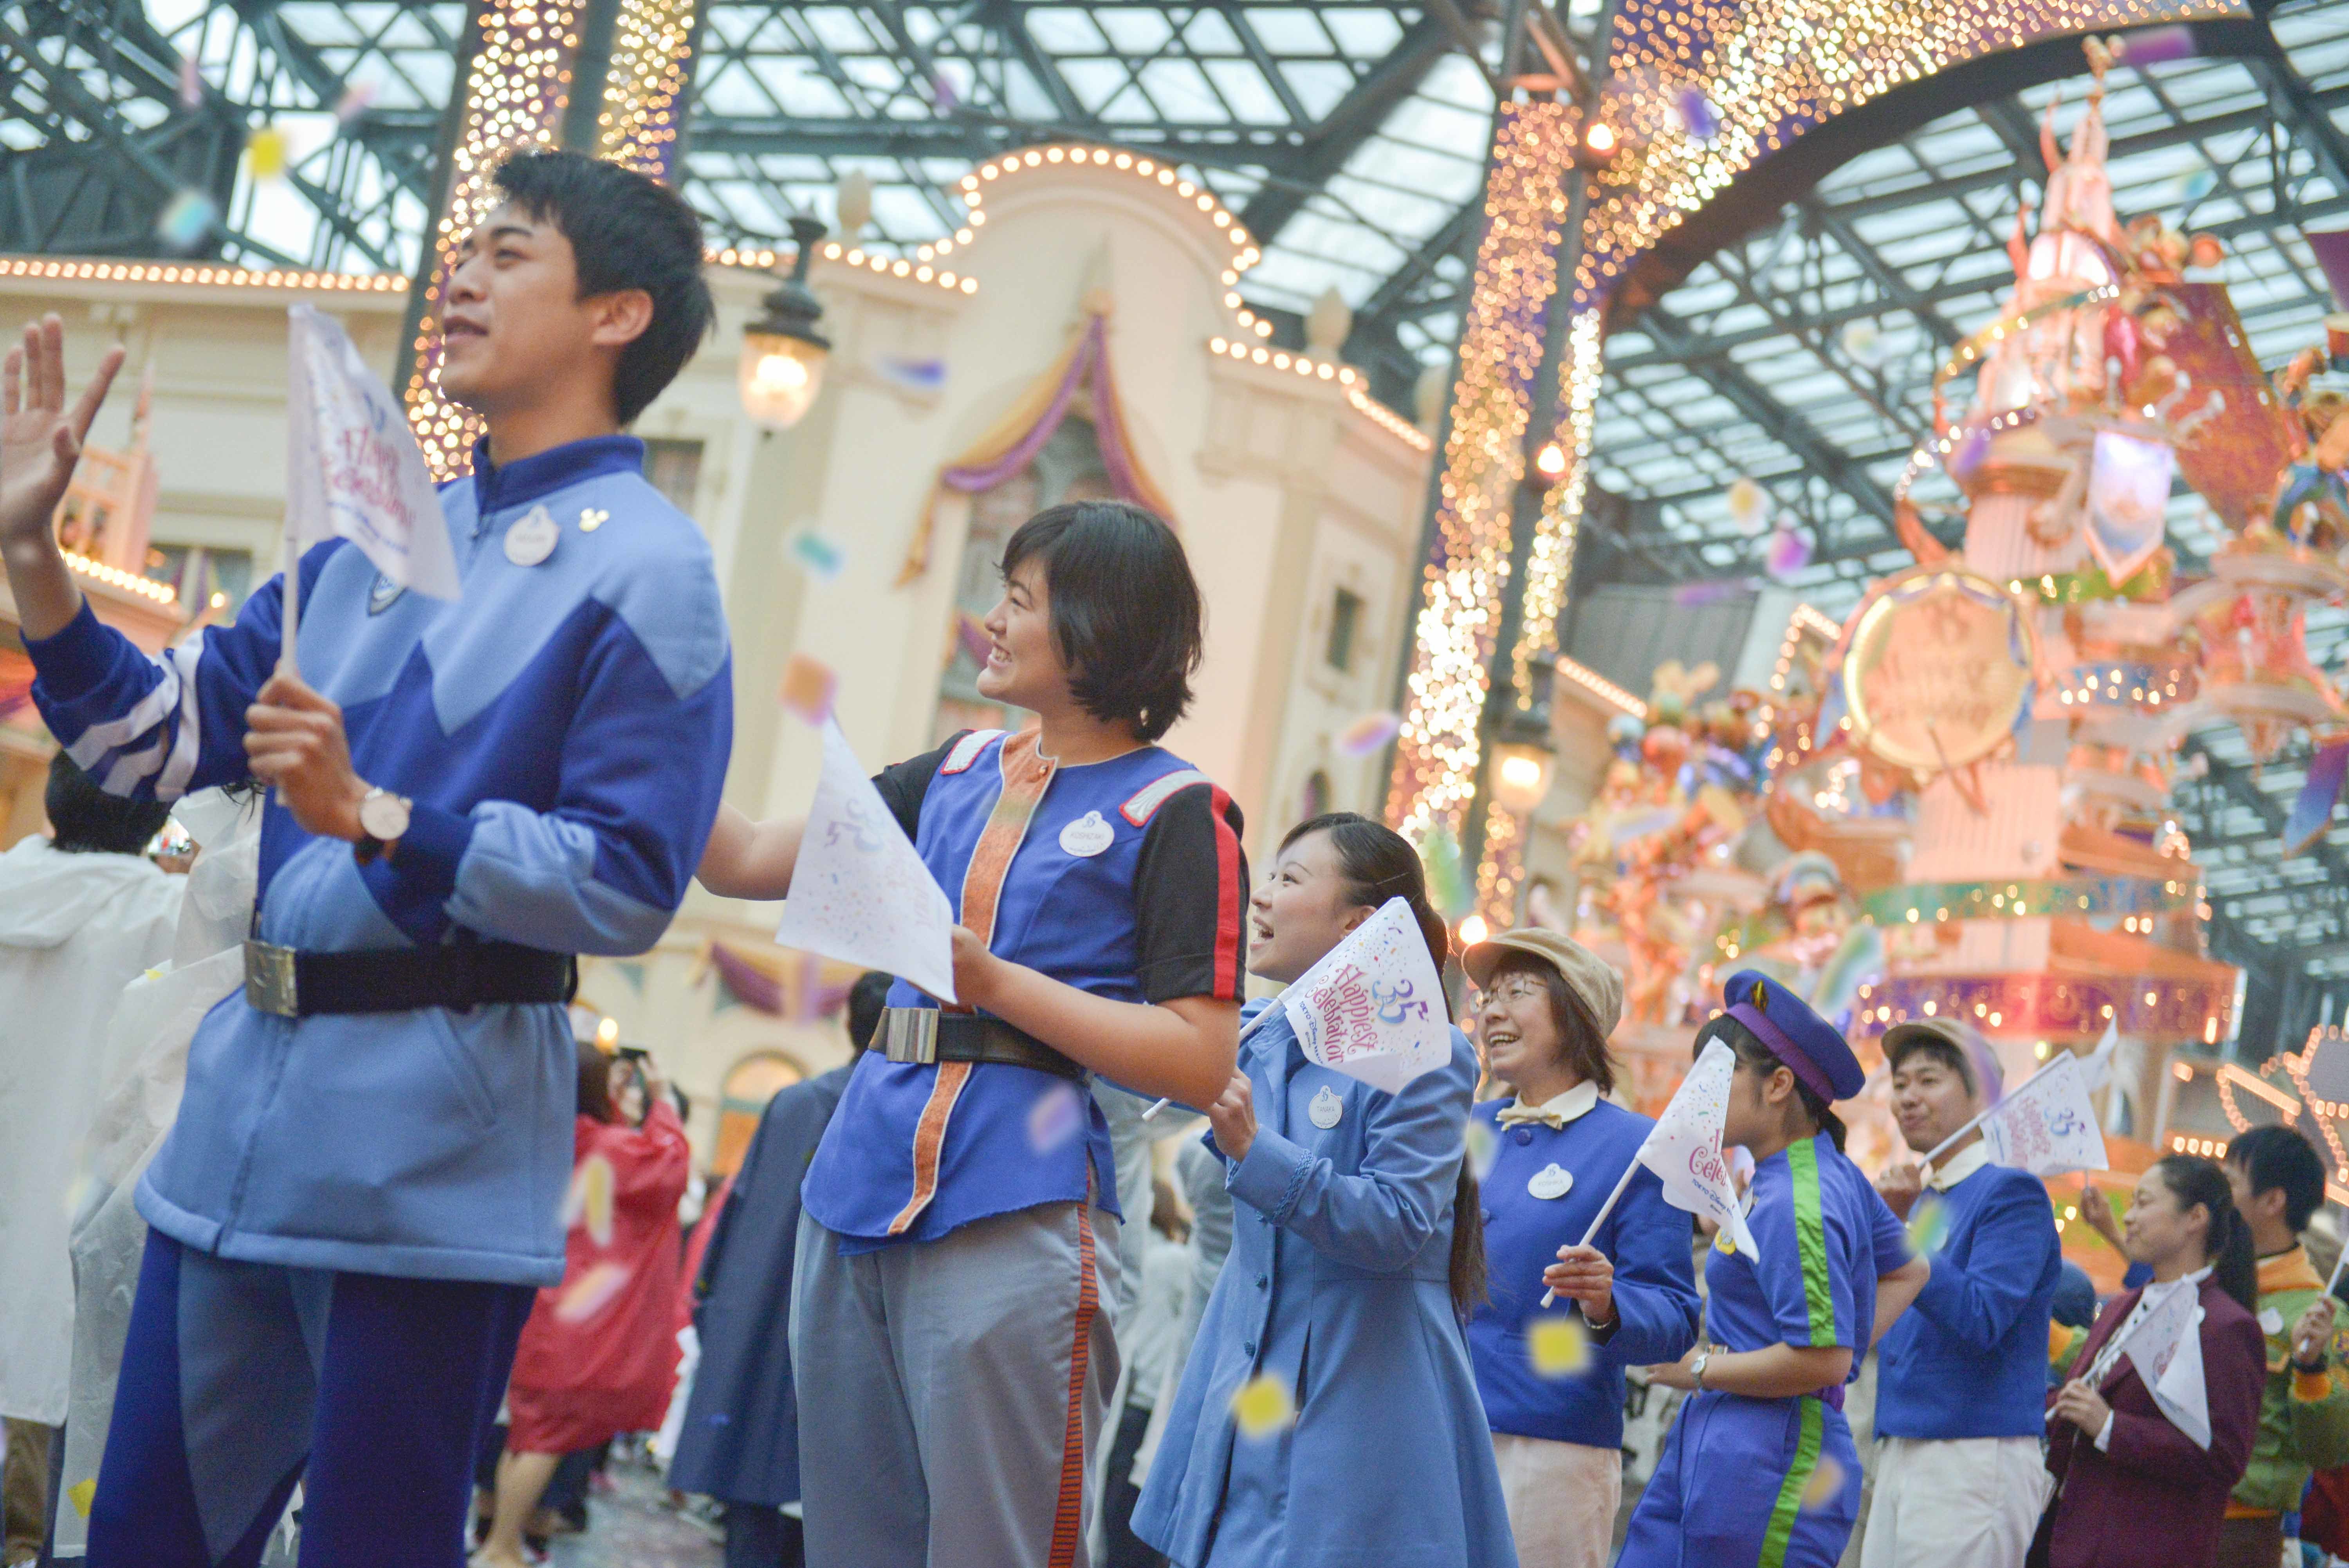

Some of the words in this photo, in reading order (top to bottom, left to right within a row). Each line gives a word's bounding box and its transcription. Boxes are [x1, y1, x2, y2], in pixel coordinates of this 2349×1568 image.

[1299, 1001, 1311, 1020] TOKYO
[1334, 963, 1377, 1054] Happiest
[1371, 979, 1429, 1024] 35
